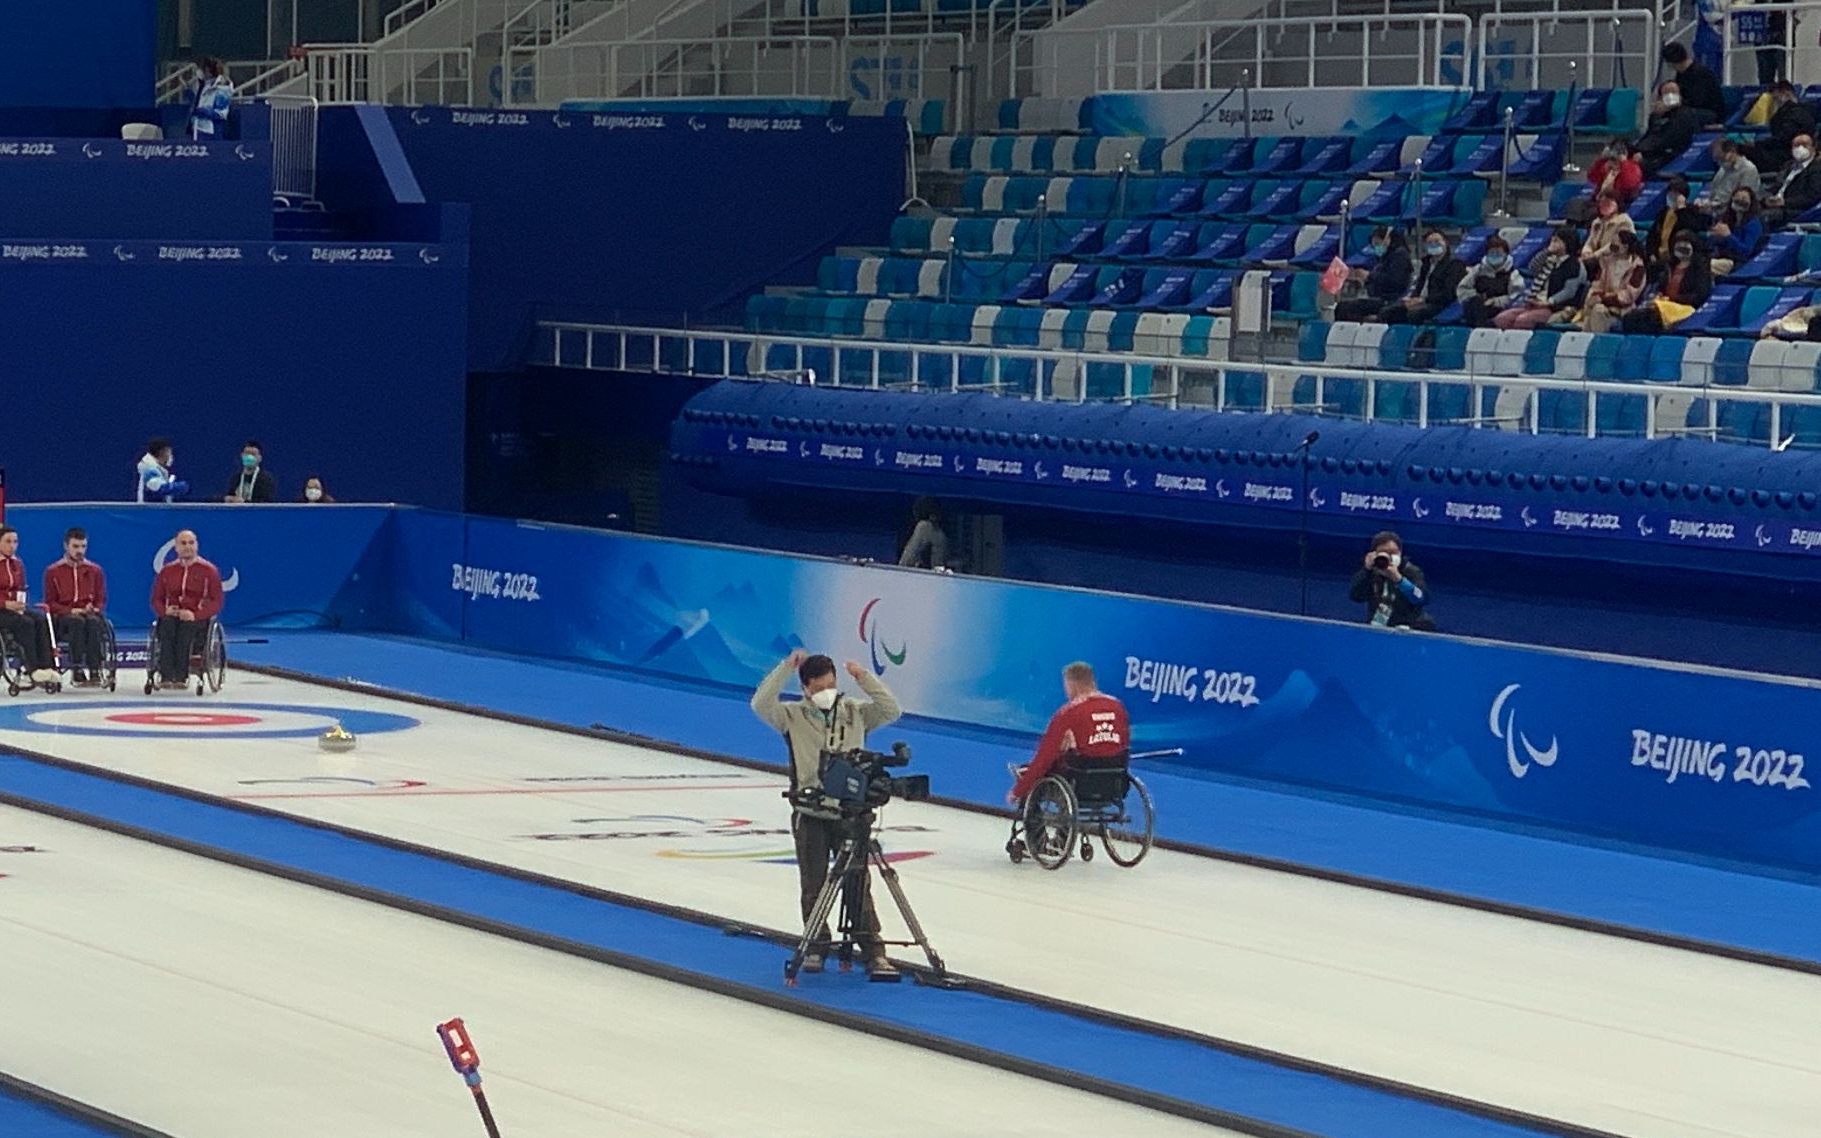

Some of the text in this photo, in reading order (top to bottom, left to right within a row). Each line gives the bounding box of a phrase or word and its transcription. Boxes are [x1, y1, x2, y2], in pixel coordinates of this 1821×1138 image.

[452, 111, 529, 127] BEIJING 2022
[727, 117, 802, 132] BEIJING 2022
[21, 142, 56, 155] 2022
[126, 143, 209, 160] BEIJING 2022
[2, 244, 88, 261] BEIJING 2022
[158, 246, 242, 262] BEIJING 2022
[311, 247, 394, 264] BEIJING 2022
[1553, 509, 1621, 530] BEIJING 2022
[1668, 519, 1735, 540] BEIJING 2022
[451, 563, 540, 602] BEIJING 2022
[1124, 656, 1260, 708] BEIJING 2022
[1630, 729, 1811, 790] BEIJING 2022
